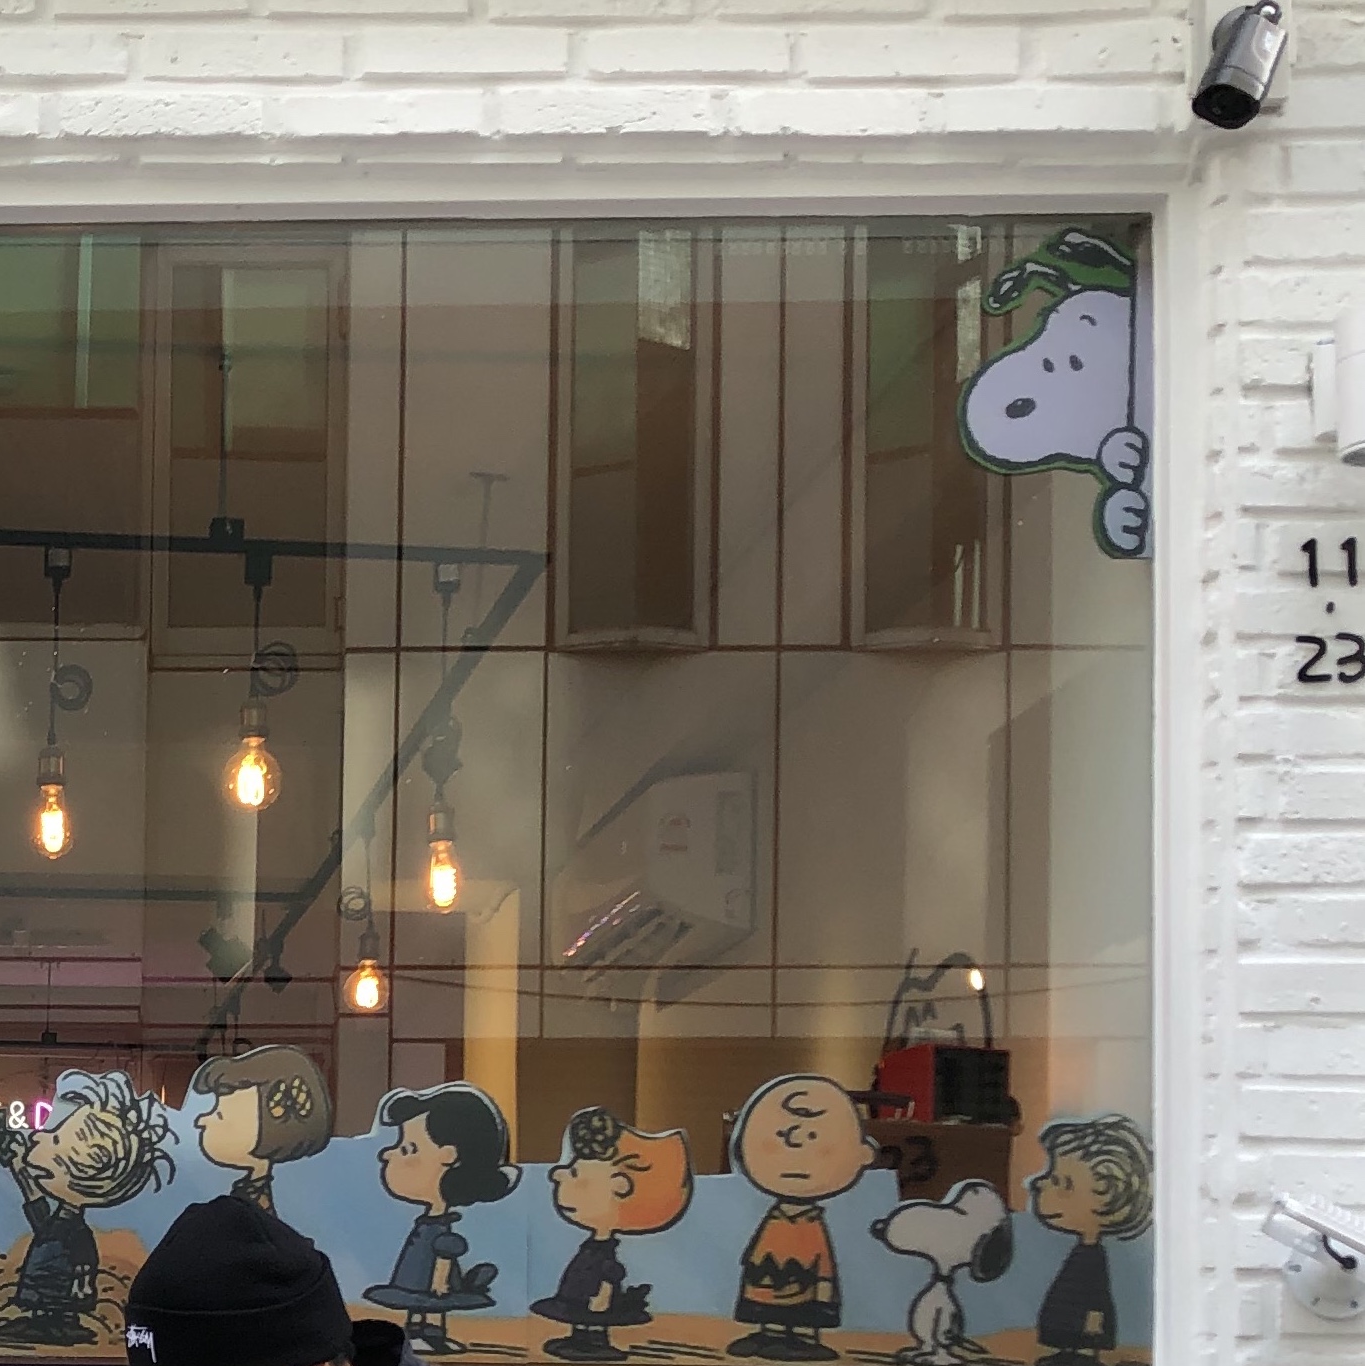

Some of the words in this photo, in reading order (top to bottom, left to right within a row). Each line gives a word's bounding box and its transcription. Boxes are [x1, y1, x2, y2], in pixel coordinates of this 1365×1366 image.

[1300, 537, 1358, 588] 11
[1296, 632, 1365, 683] 23
[9, 1101, 29, 1129] &
